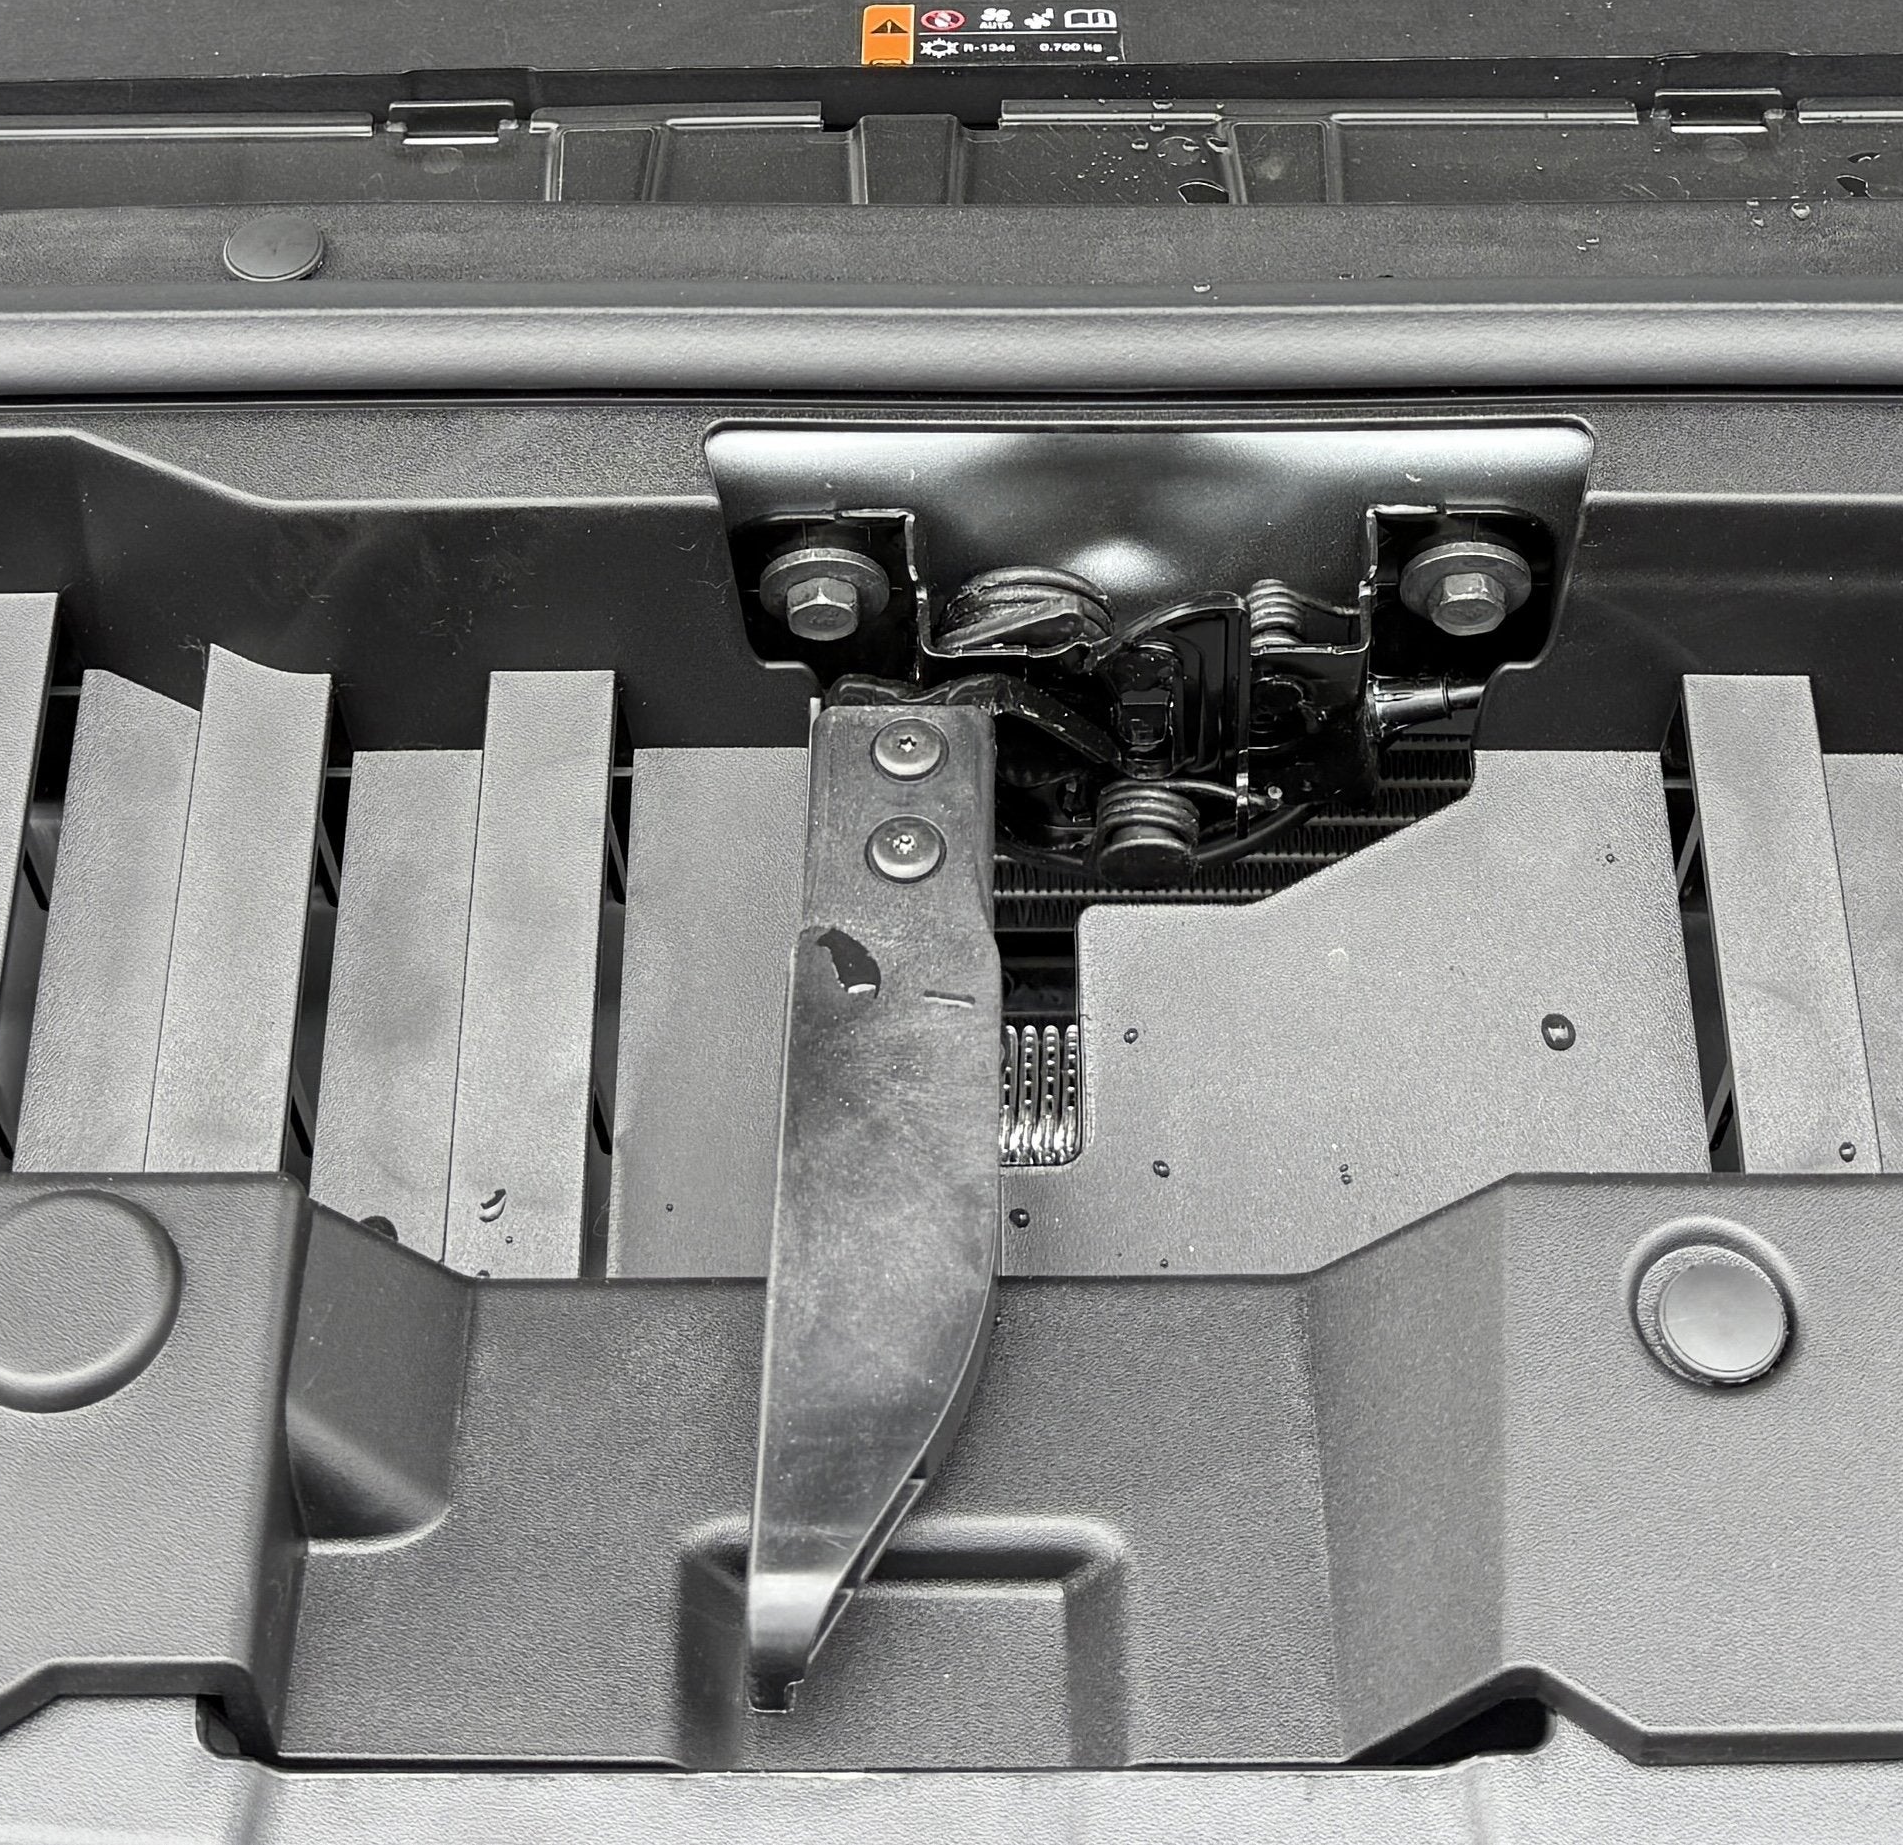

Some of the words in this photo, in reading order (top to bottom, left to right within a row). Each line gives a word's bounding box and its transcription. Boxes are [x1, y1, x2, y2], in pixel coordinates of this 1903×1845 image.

[979, 21, 1015, 30] AUTO
[963, 43, 1016, 53] R-134a
[1039, 42, 1081, 53] 0.700
[1083, 42, 1103, 54] kg
